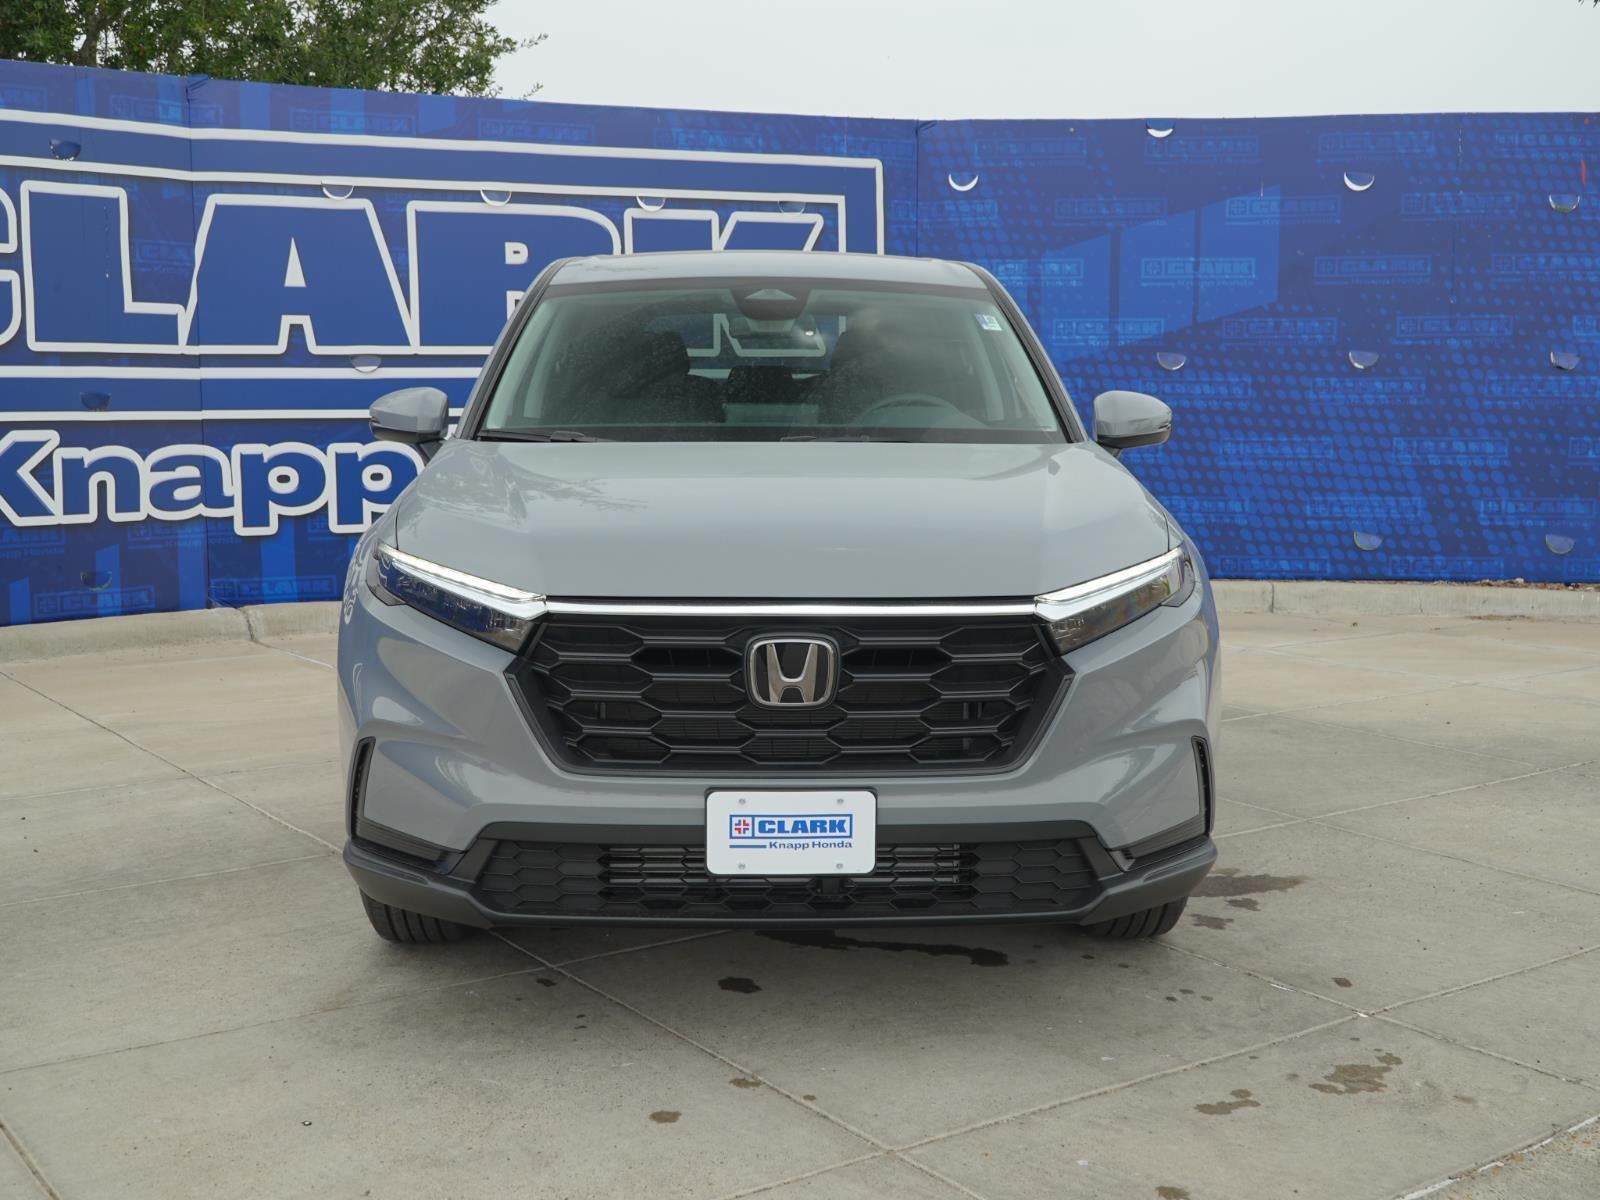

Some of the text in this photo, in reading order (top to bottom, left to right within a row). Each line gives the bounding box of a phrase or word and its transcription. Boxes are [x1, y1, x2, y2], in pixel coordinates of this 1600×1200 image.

[1168, 261, 1250, 274] CLARK
[758, 819, 847, 834] CLARK
[769, 840, 852, 850] Knapp Honda
